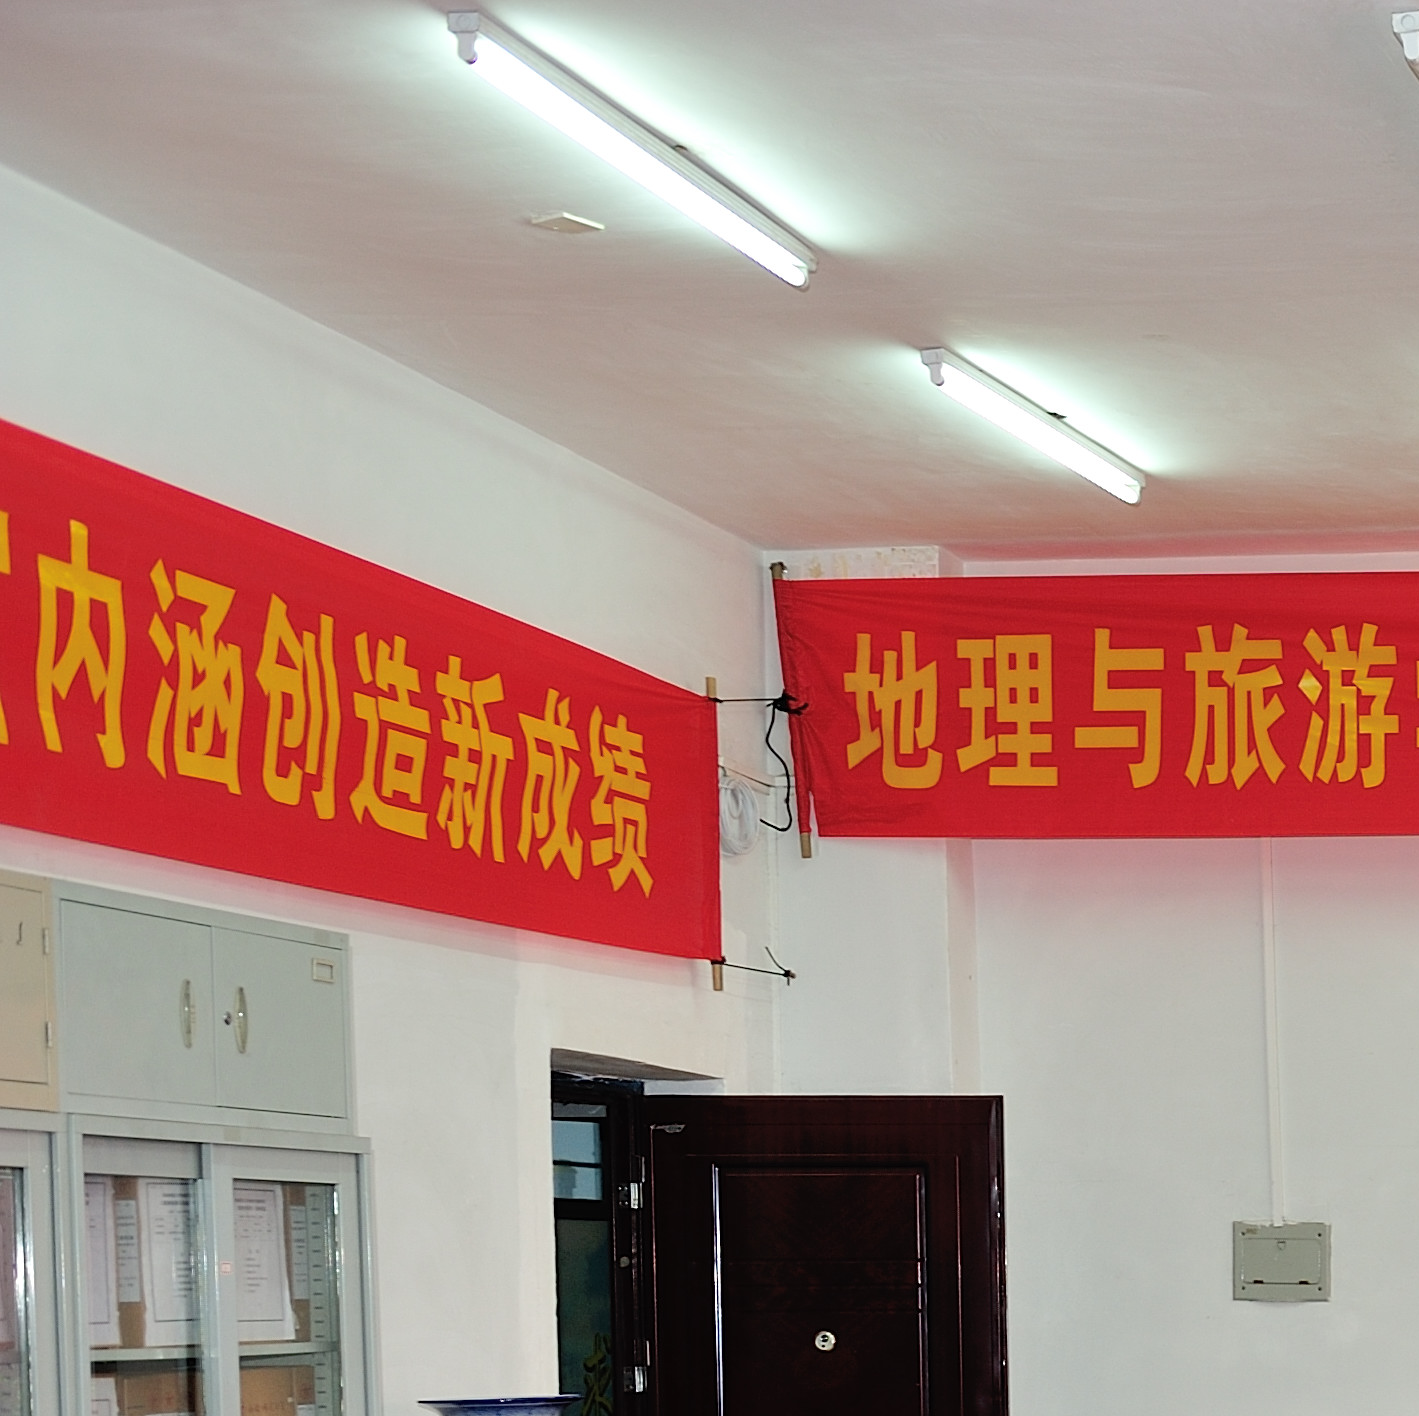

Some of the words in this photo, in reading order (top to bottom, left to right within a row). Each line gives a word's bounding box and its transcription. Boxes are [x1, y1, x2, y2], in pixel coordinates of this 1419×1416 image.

[0, 512, 654, 896] 内涵创造新成绩
